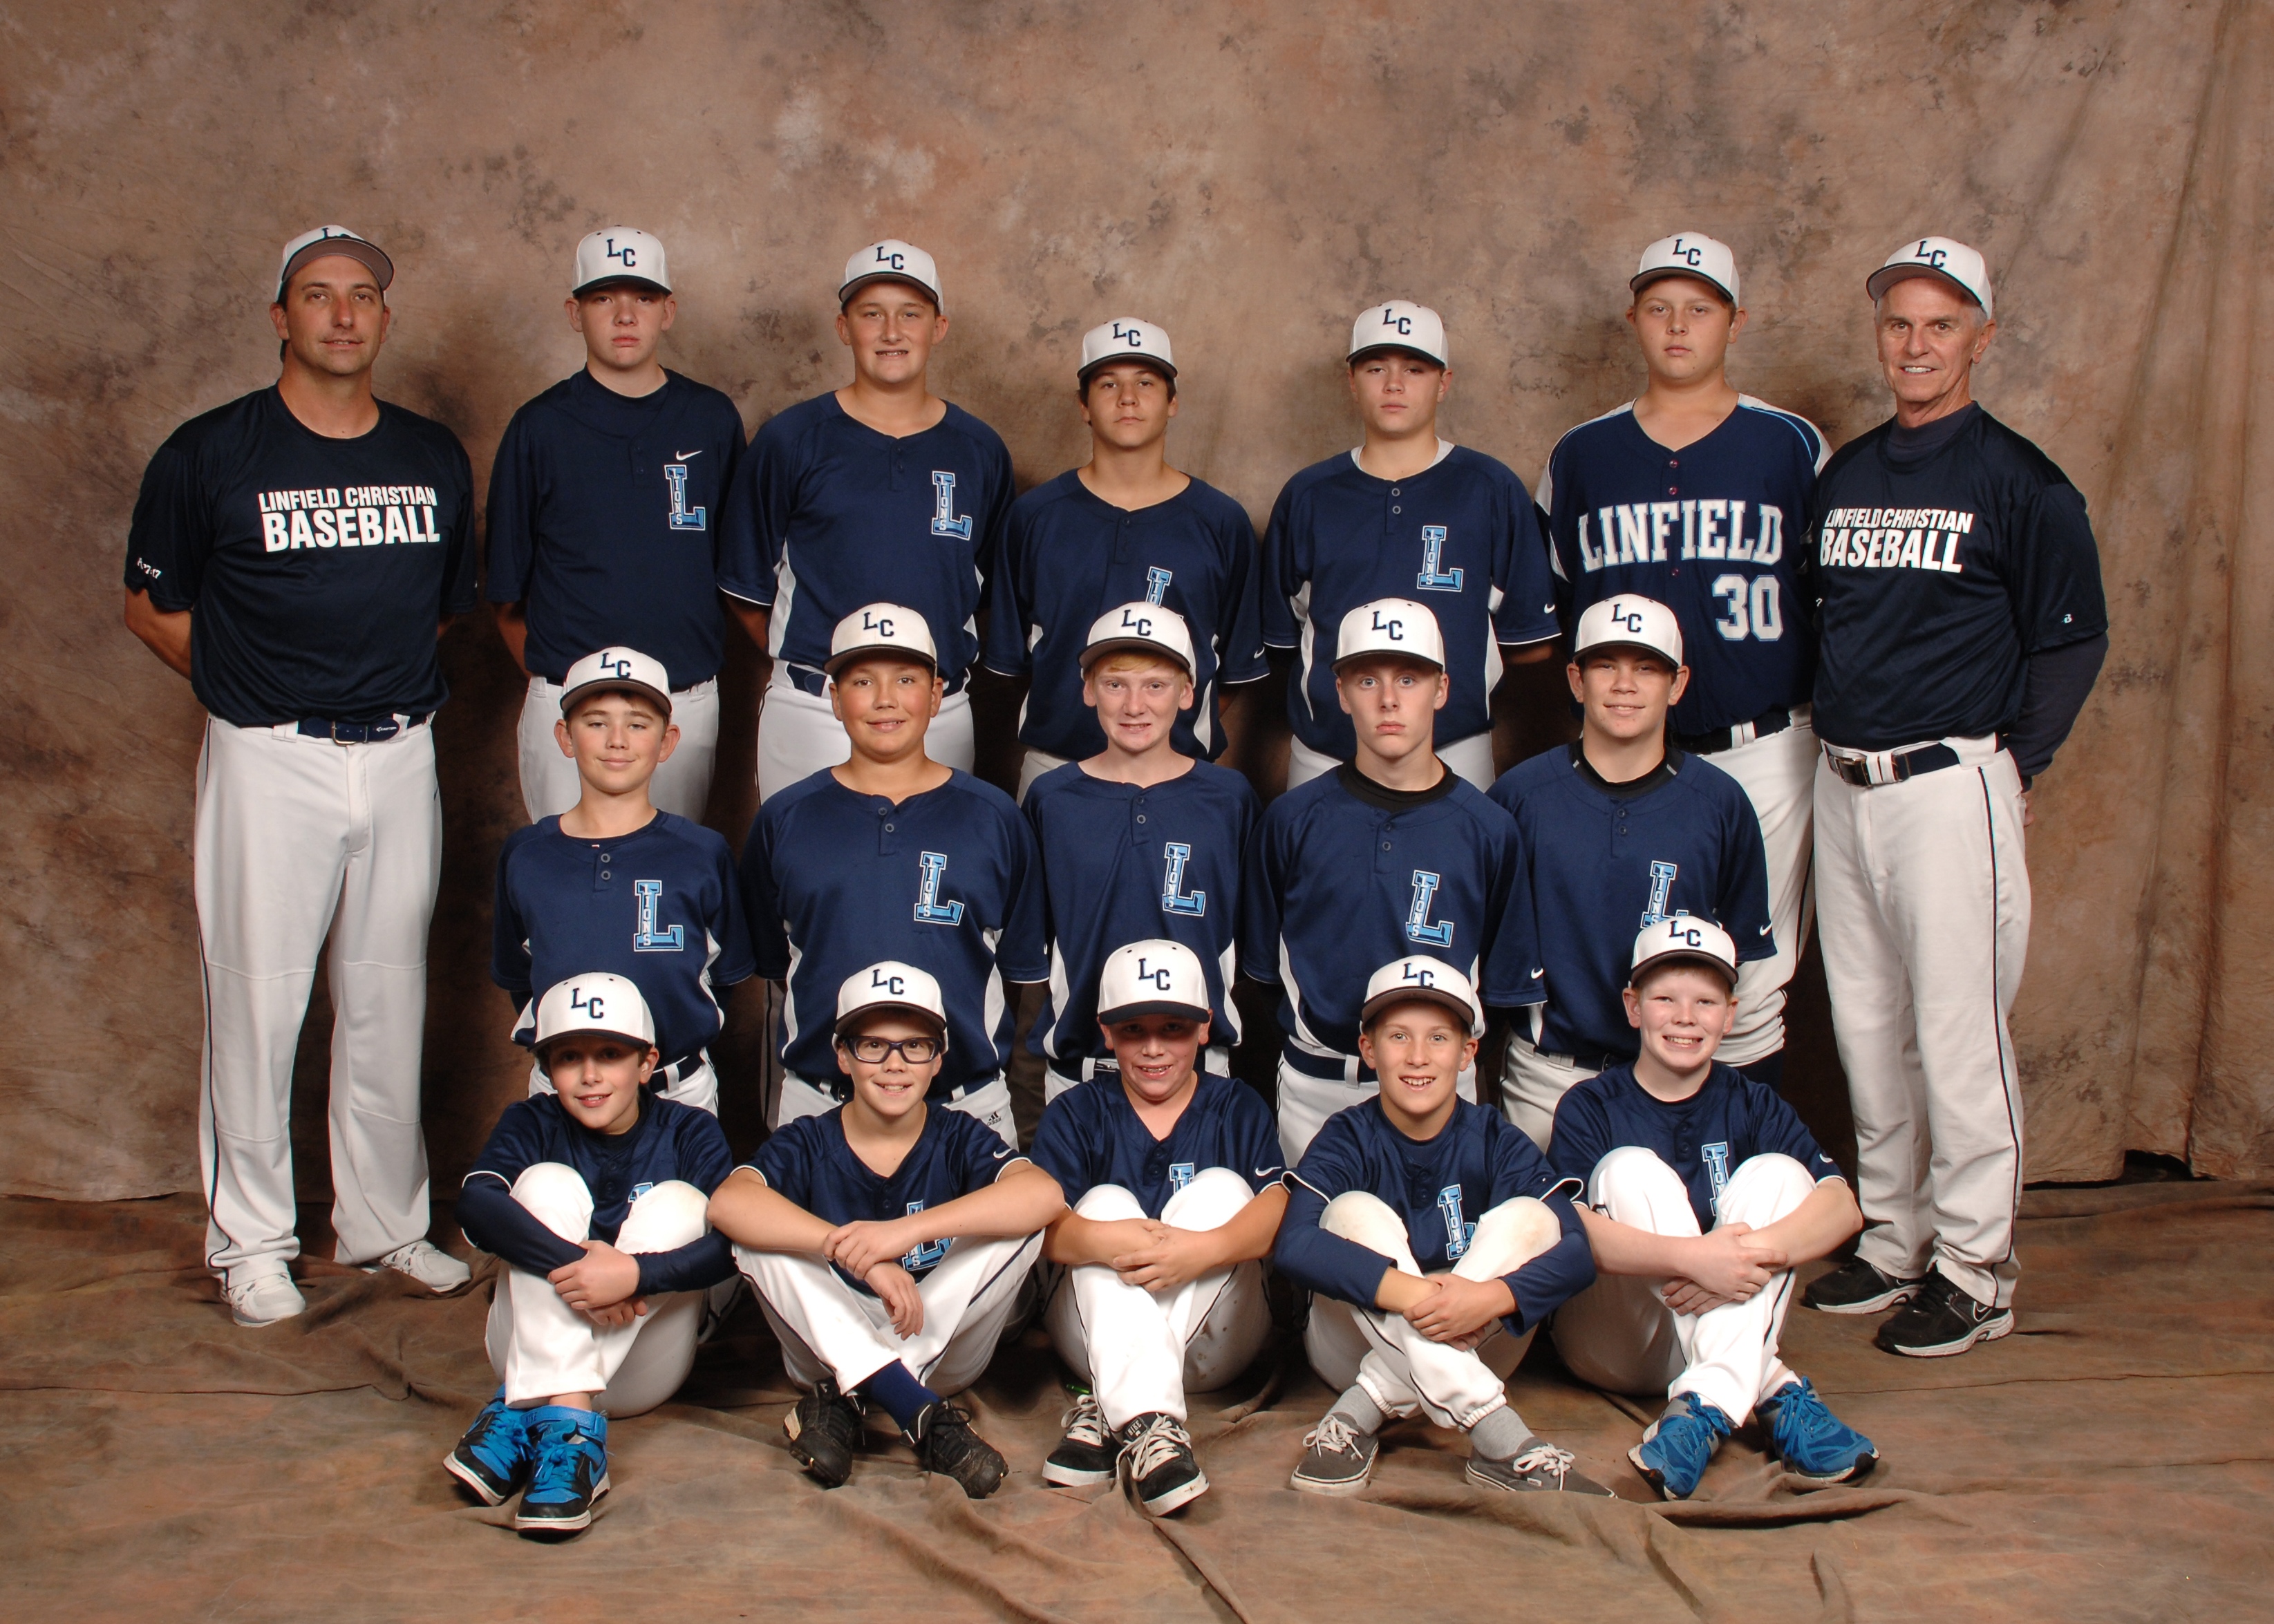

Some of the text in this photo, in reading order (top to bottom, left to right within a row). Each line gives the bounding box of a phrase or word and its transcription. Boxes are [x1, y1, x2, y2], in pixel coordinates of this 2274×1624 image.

[259, 485, 437, 513] LINFIELD CHRISTIAN
[670, 468, 683, 527] LIONS
[939, 474, 949, 531] LIONS
[1824, 508, 1973, 534] LINFIELD CHRISTIAN
[261, 505, 440, 553] BASEBALL
[1425, 529, 1438, 586] LIONS
[1578, 498, 1783, 573] LINFIELD
[1820, 528, 1963, 574] BASEBALL
[1711, 574, 1783, 642] 30
[923, 856, 934, 918] LIONS
[1168, 847, 1181, 908] LIONS
[1411, 876, 1429, 937] LIONS
[641, 883, 652, 947] LIONS
[1444, 1191, 1463, 1254] LIONS
